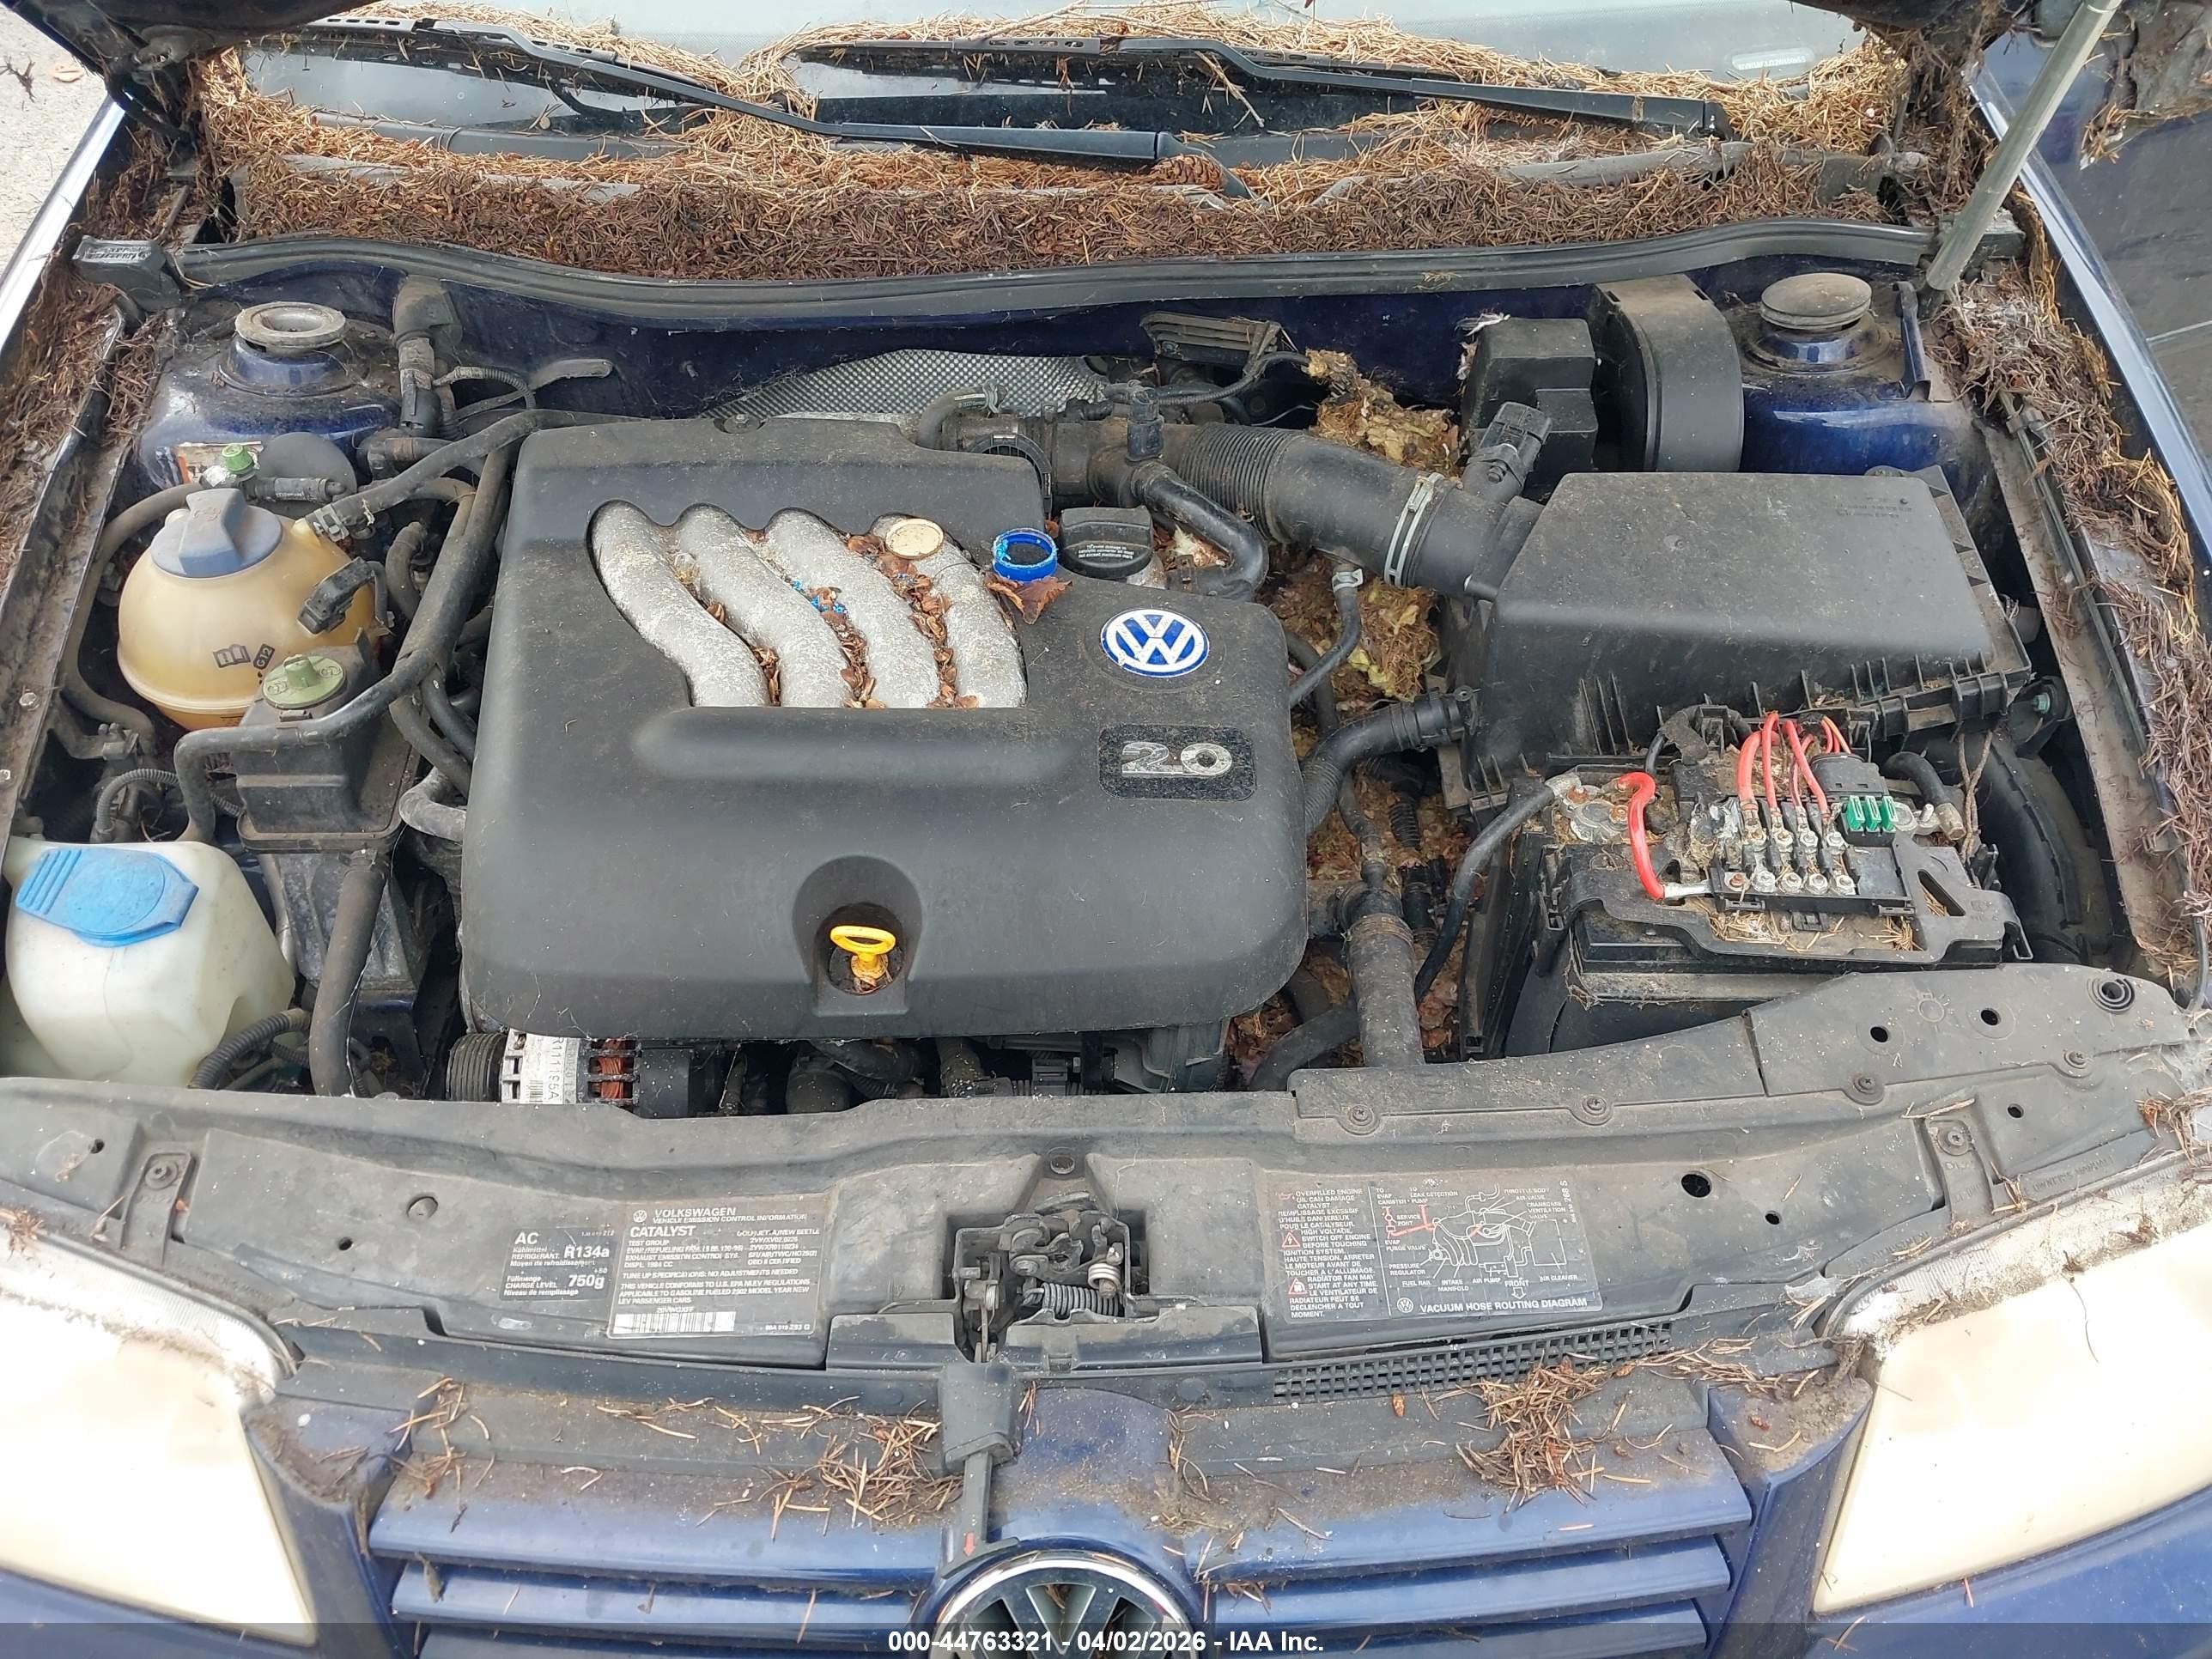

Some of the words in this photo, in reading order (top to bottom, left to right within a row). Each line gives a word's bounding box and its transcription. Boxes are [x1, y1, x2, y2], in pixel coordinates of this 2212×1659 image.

[256, 647, 273, 666] G12
[1295, 1188, 1336, 1197] OVERFILLED
[1561, 1188, 1572, 1203] 268
[655, 1207, 737, 1218] VOLKSWAGEN
[515, 1231, 538, 1245] AC
[630, 1225, 696, 1238] CATALYST
[563, 1245, 610, 1259] R134a
[568, 1274, 605, 1290] 750g
[1504, 1279, 1530, 1288] FRONT
[1419, 1303, 1464, 1313] VACUUM
[1466, 1302, 1494, 1311] HOSE
[1494, 1300, 1540, 1310] ROUTING
[1540, 1297, 1588, 1309] DIAGRAM
